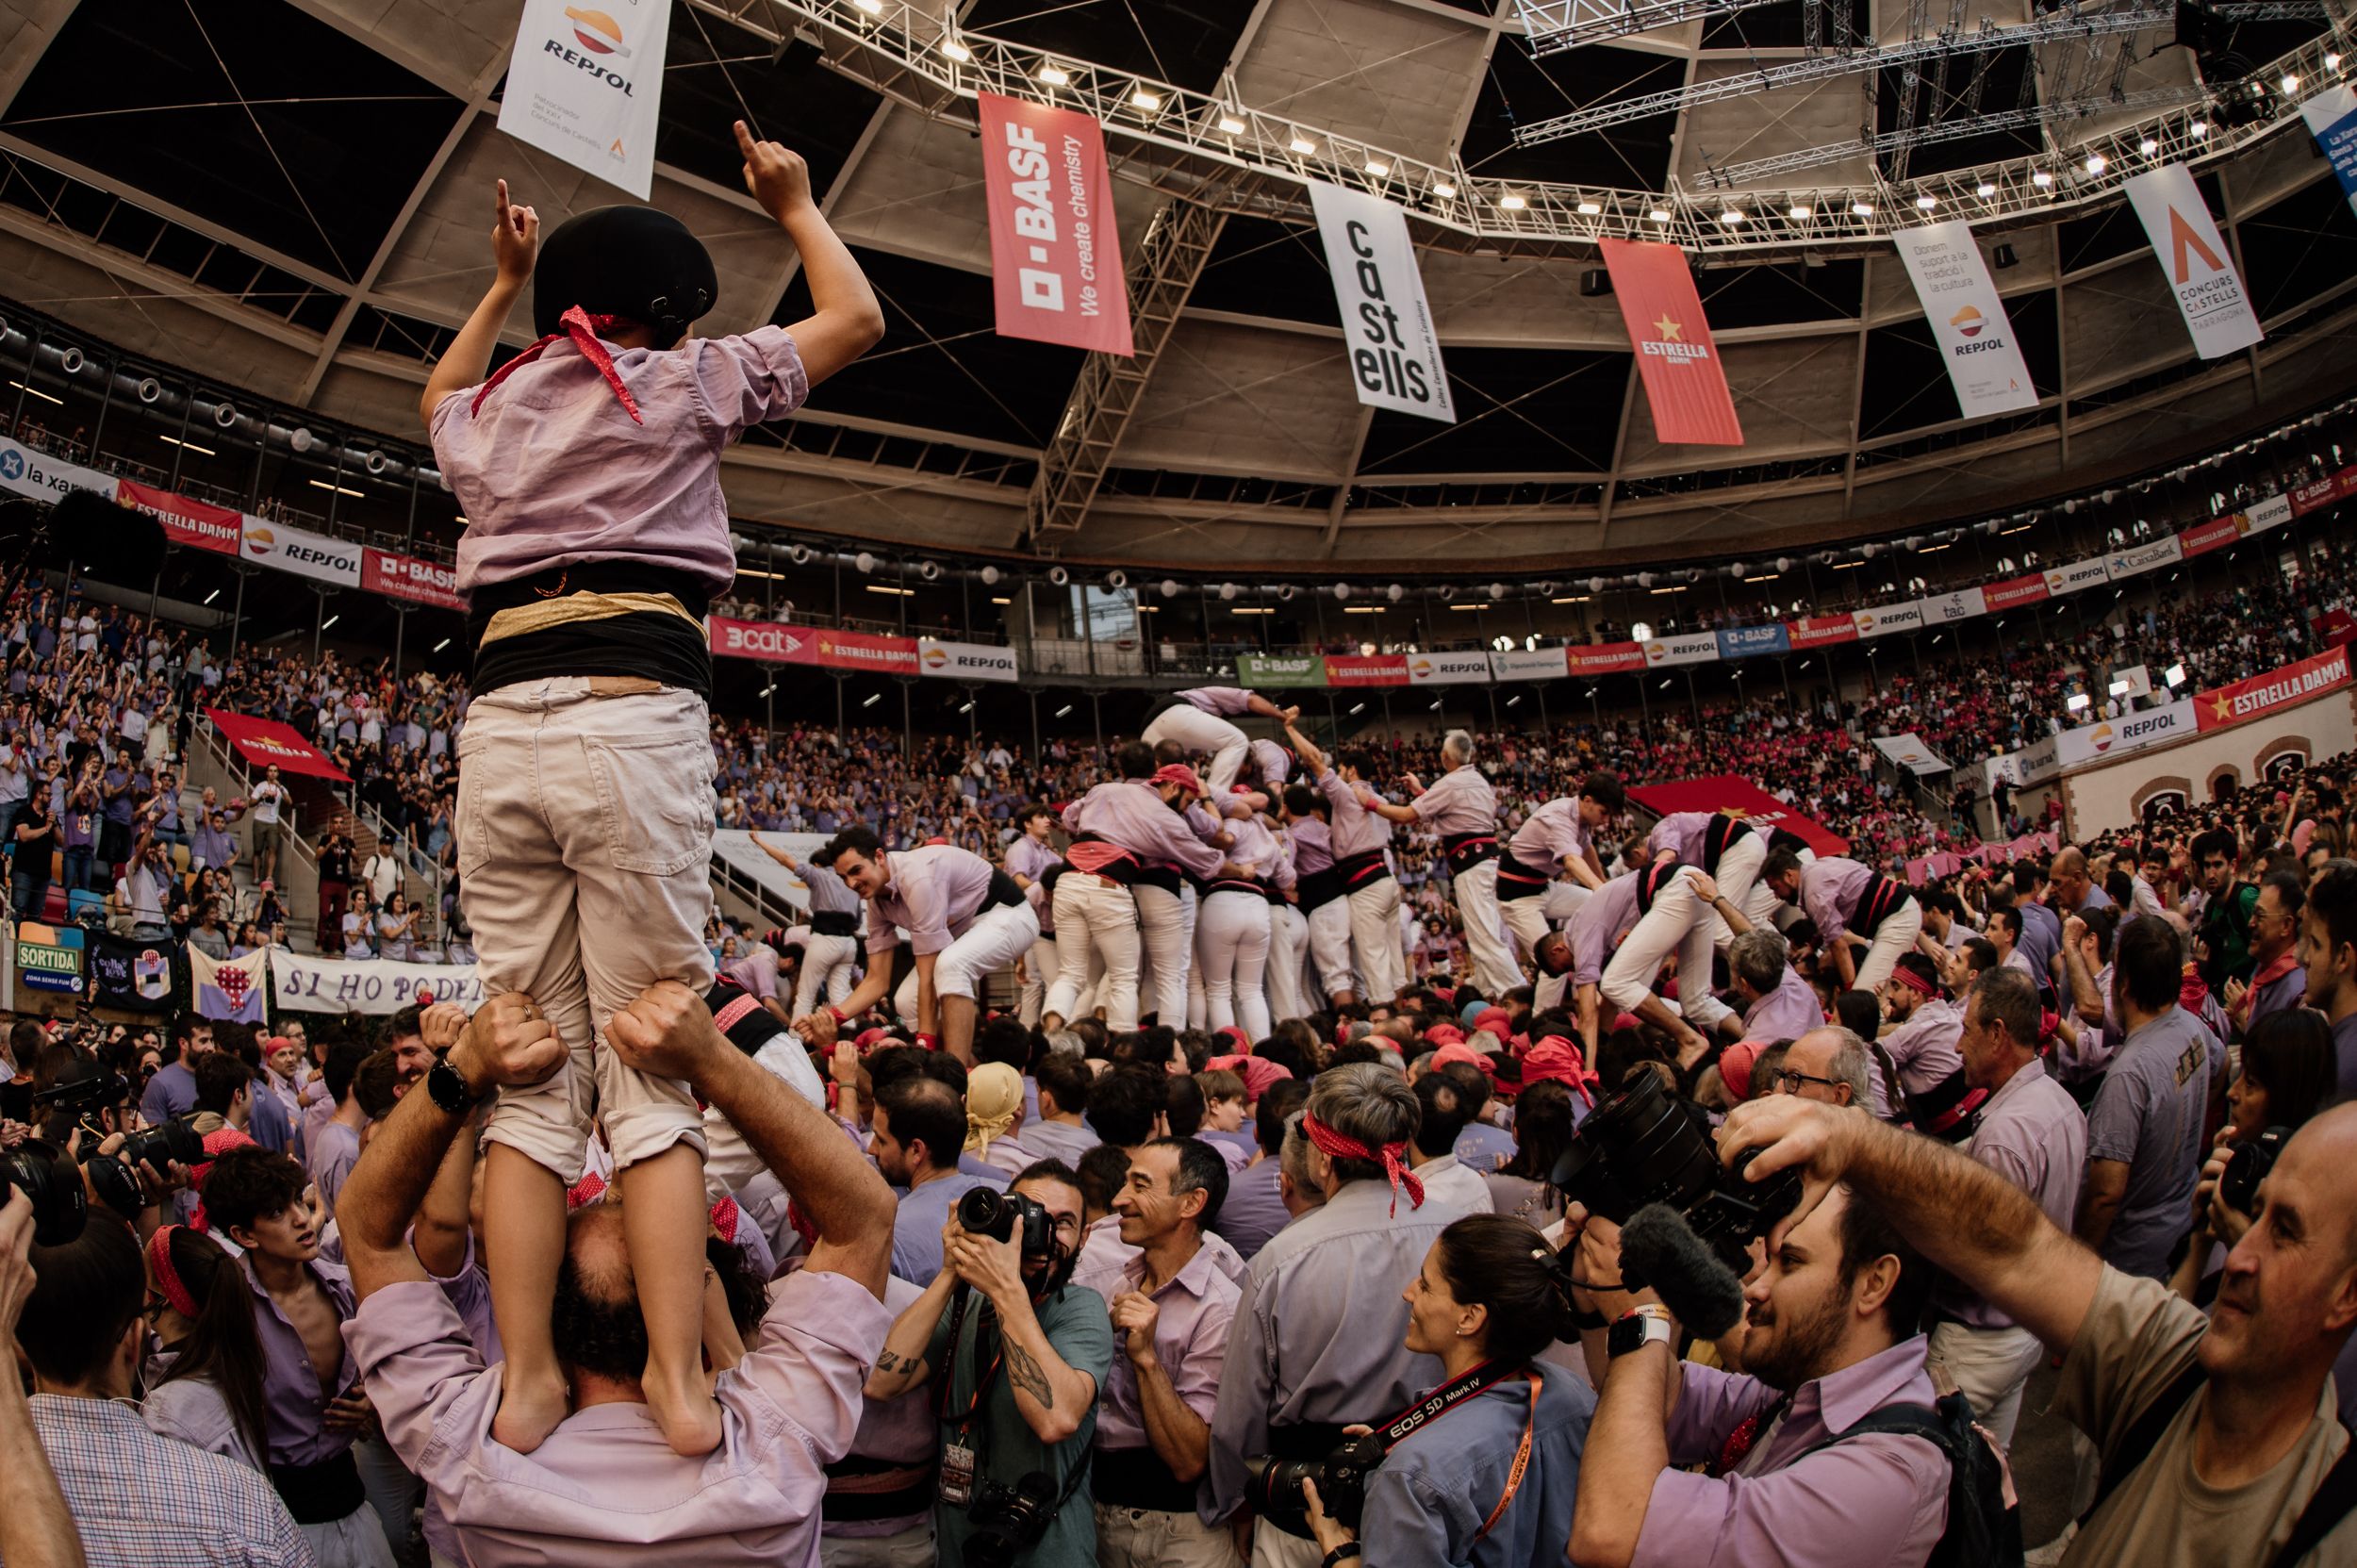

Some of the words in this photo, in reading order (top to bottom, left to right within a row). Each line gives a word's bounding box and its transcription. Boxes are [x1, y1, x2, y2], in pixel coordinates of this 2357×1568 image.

[544, 39, 634, 98] REPSOL
[1005, 122, 1057, 241] BASF
[1063, 135, 1089, 219] chemistry
[1073, 223, 1095, 281] create
[1913, 241, 1948, 256] Donem
[1920, 254, 1949, 269] suport
[1951, 254, 1957, 263] a
[1957, 251, 1969, 261] la
[1930, 282, 1940, 294] la
[1940, 276, 1974, 291] cultura
[2180, 273, 2233, 301] CONCURS
[1081, 289, 1100, 317] We
[2185, 287, 2239, 314] CASTELLS
[2192, 306, 2248, 331] TARRAGONA
[1640, 341, 1709, 359] ESTRELLA
[1955, 338, 2004, 356] REPSOL
[27, 463, 43, 485] la
[2308, 478, 2332, 498] BASF
[2256, 503, 2291, 523] REPSOL
[198, 520, 239, 541] DAMM
[2189, 532, 2218, 549] ESTRELLA
[285, 544, 357, 573] REPSOL
[2128, 543, 2176, 568] CaixaBank
[2069, 566, 2105, 583] REPSOL
[380, 577, 394, 589] We
[394, 581, 420, 595] create
[1994, 588, 2027, 602] ESTRELLA
[2026, 582, 2047, 596] DAMM
[1880, 610, 1920, 625] REPSOL
[1943, 604, 1966, 619] tac
[726, 626, 785, 652] 3cat
[1744, 628, 1776, 642] BASF
[835, 644, 883, 660] ESTRELLA
[885, 650, 916, 663] DAMM
[1673, 642, 1717, 655] REPSOL
[957, 655, 1014, 670] REPSOL
[1271, 659, 1311, 672] BASF
[1440, 662, 1487, 673] REPSOL
[1581, 654, 1619, 666] ESTRELLA
[1339, 667, 1379, 678] ESTRELLA
[2233, 678, 2302, 716] ESTRELLA
[2302, 658, 2348, 693] DAMM
[2122, 713, 2176, 739] REPSOL
[241, 738, 313, 758] ESTRELLA
[20, 946, 75, 971] SORTIDA
[41, 976, 58, 984] SENSE
[58, 978, 71, 986] FUM
[283, 969, 321, 997] SI
[336, 973, 382, 1001] HO
[118, 1164, 135, 1192] Canon
[1390, 1411, 1426, 1439] EOS
[1426, 1396, 1443, 1416] 5D
[1445, 1384, 1471, 1403] Mark
[1470, 1378, 1480, 1390] IV
